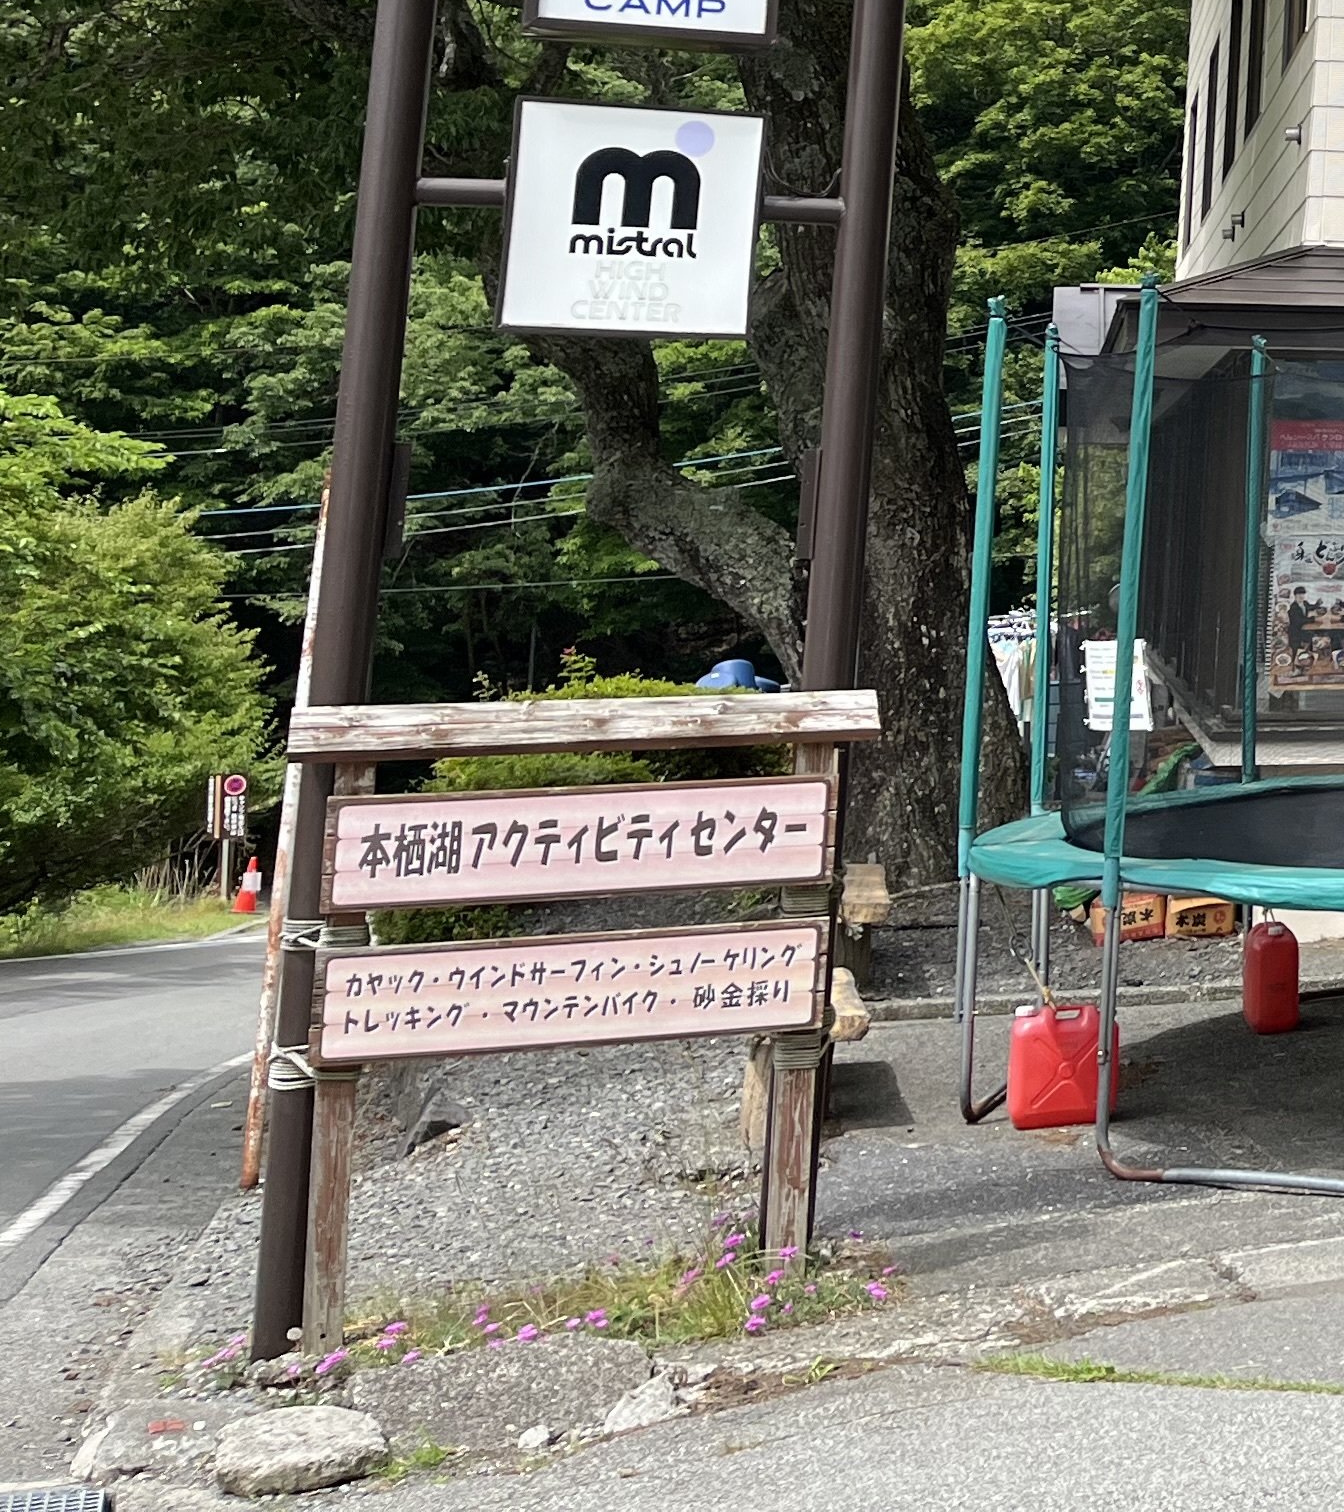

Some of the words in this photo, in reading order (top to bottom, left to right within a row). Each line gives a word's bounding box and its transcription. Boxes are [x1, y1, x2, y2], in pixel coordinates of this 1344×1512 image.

[569, 227, 697, 259] mistral
[594, 260, 666, 281] HIGH
[588, 279, 669, 301] WIND
[570, 299, 681, 323] CENTER
[359, 806, 807, 878] 本栖湖アクティビティセンター
